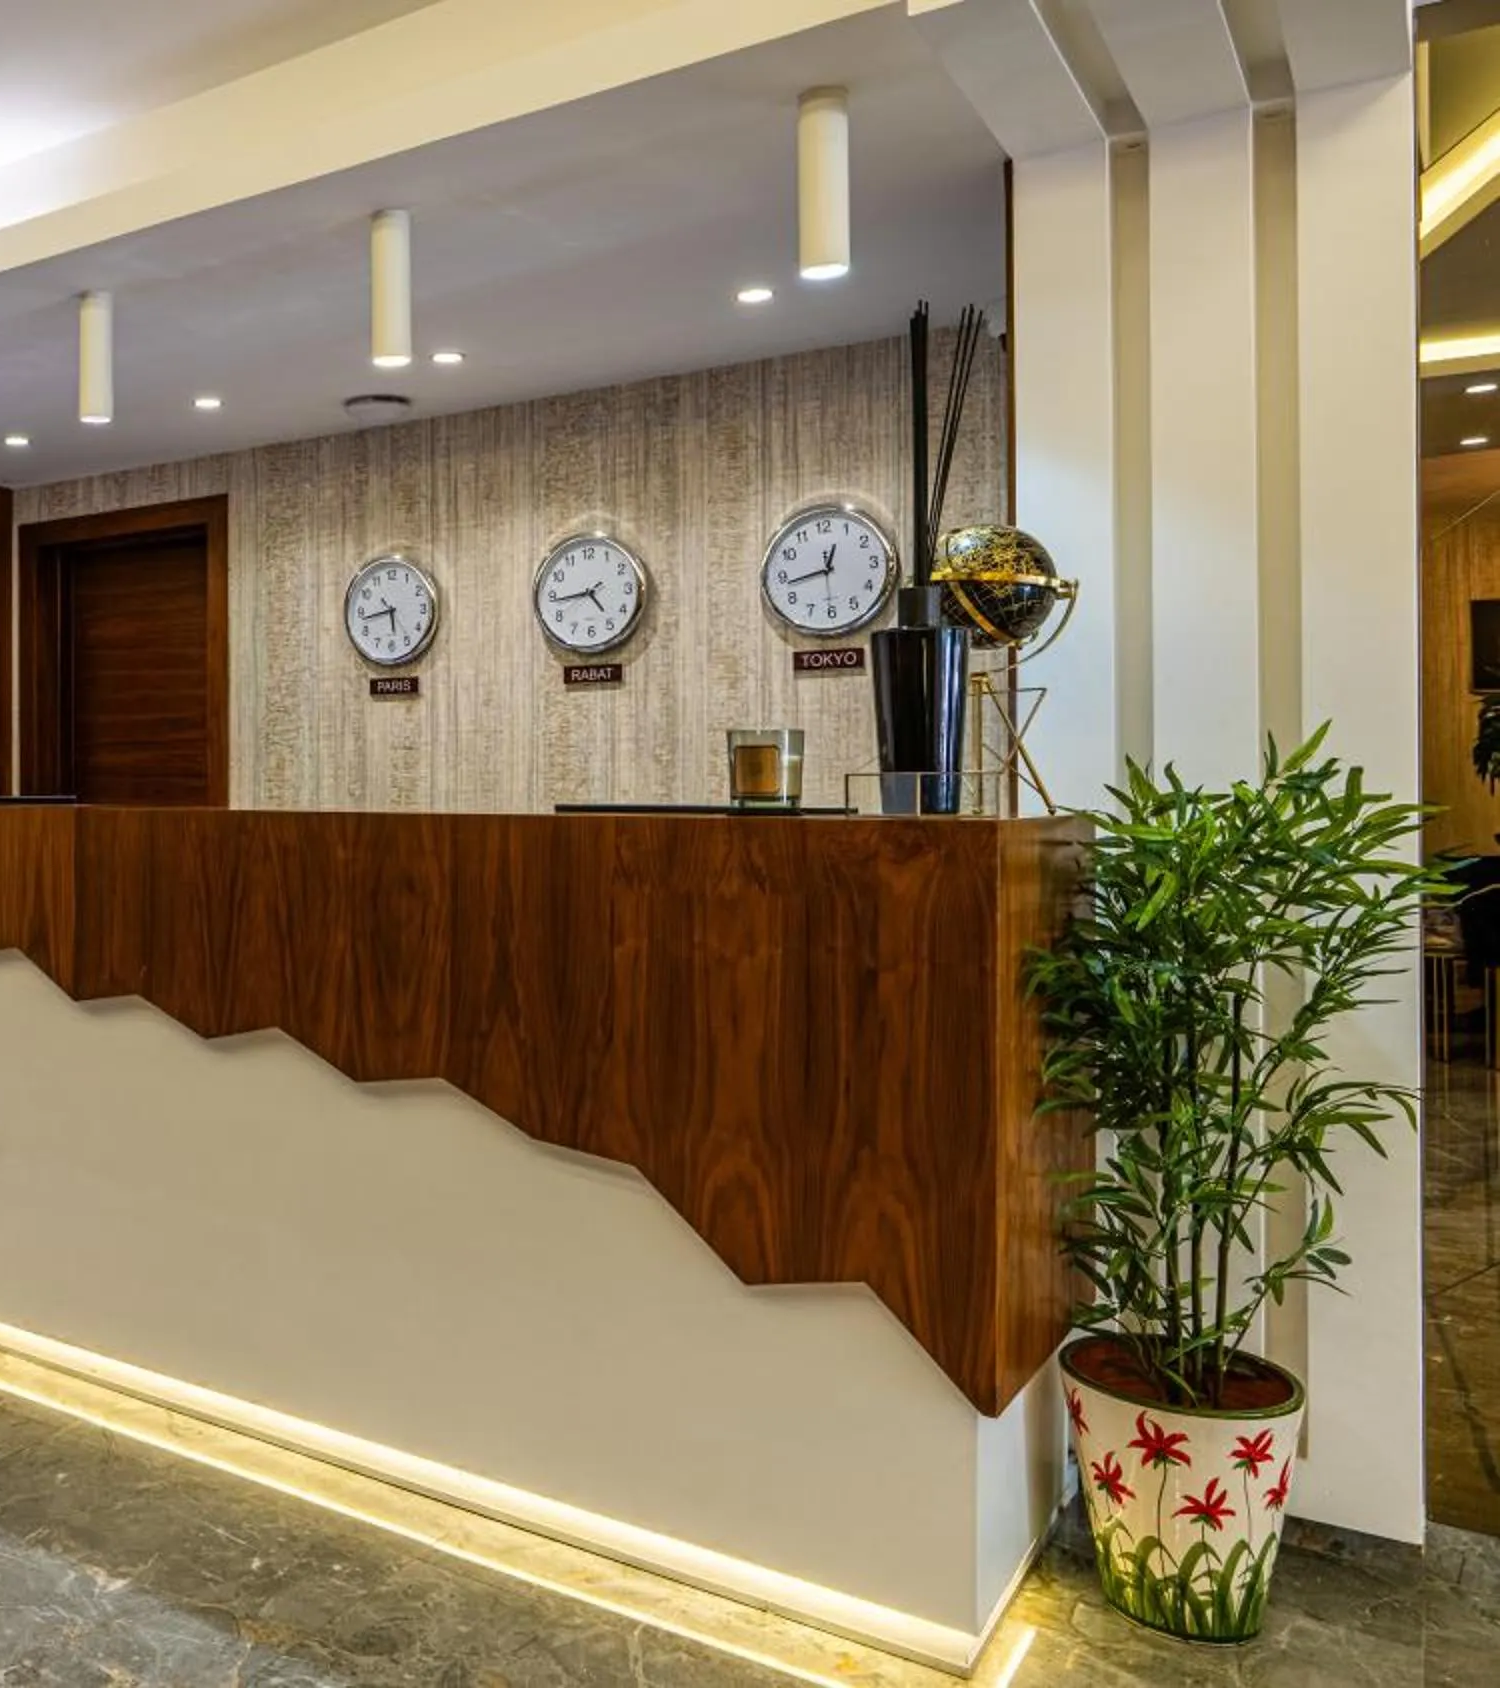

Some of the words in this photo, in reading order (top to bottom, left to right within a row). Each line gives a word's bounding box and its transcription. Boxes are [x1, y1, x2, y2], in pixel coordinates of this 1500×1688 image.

[816, 520, 832, 534] 12
[844, 523, 849, 535] 1
[796, 531, 808, 543] 11
[860, 535, 869, 548] 2
[582, 548, 594, 560] 12
[605, 551, 609, 562] 1
[782, 548, 796, 560] 10
[565, 555, 574, 566] 11
[870, 556, 879, 568] 3
[617, 563, 626, 575] 2
[553, 569, 564, 582] 10
[778, 570, 788, 584] 9
[624, 582, 632, 594] 3
[865, 580, 872, 591] 4
[548, 590, 556, 602] 9
[788, 592, 797, 604] 8
[620, 604, 626, 614] 4
[849, 597, 858, 610] 5
[556, 610, 563, 622] 8
[806, 604, 815, 617] 7
[827, 606, 837, 618] 6
[570, 623, 578, 634] 7
[606, 619, 614, 630] 5
[588, 626, 596, 637] 6
[801, 652, 857, 667] TOKYO
[572, 668, 612, 681] RABAT
[377, 680, 411, 692] PARIS
